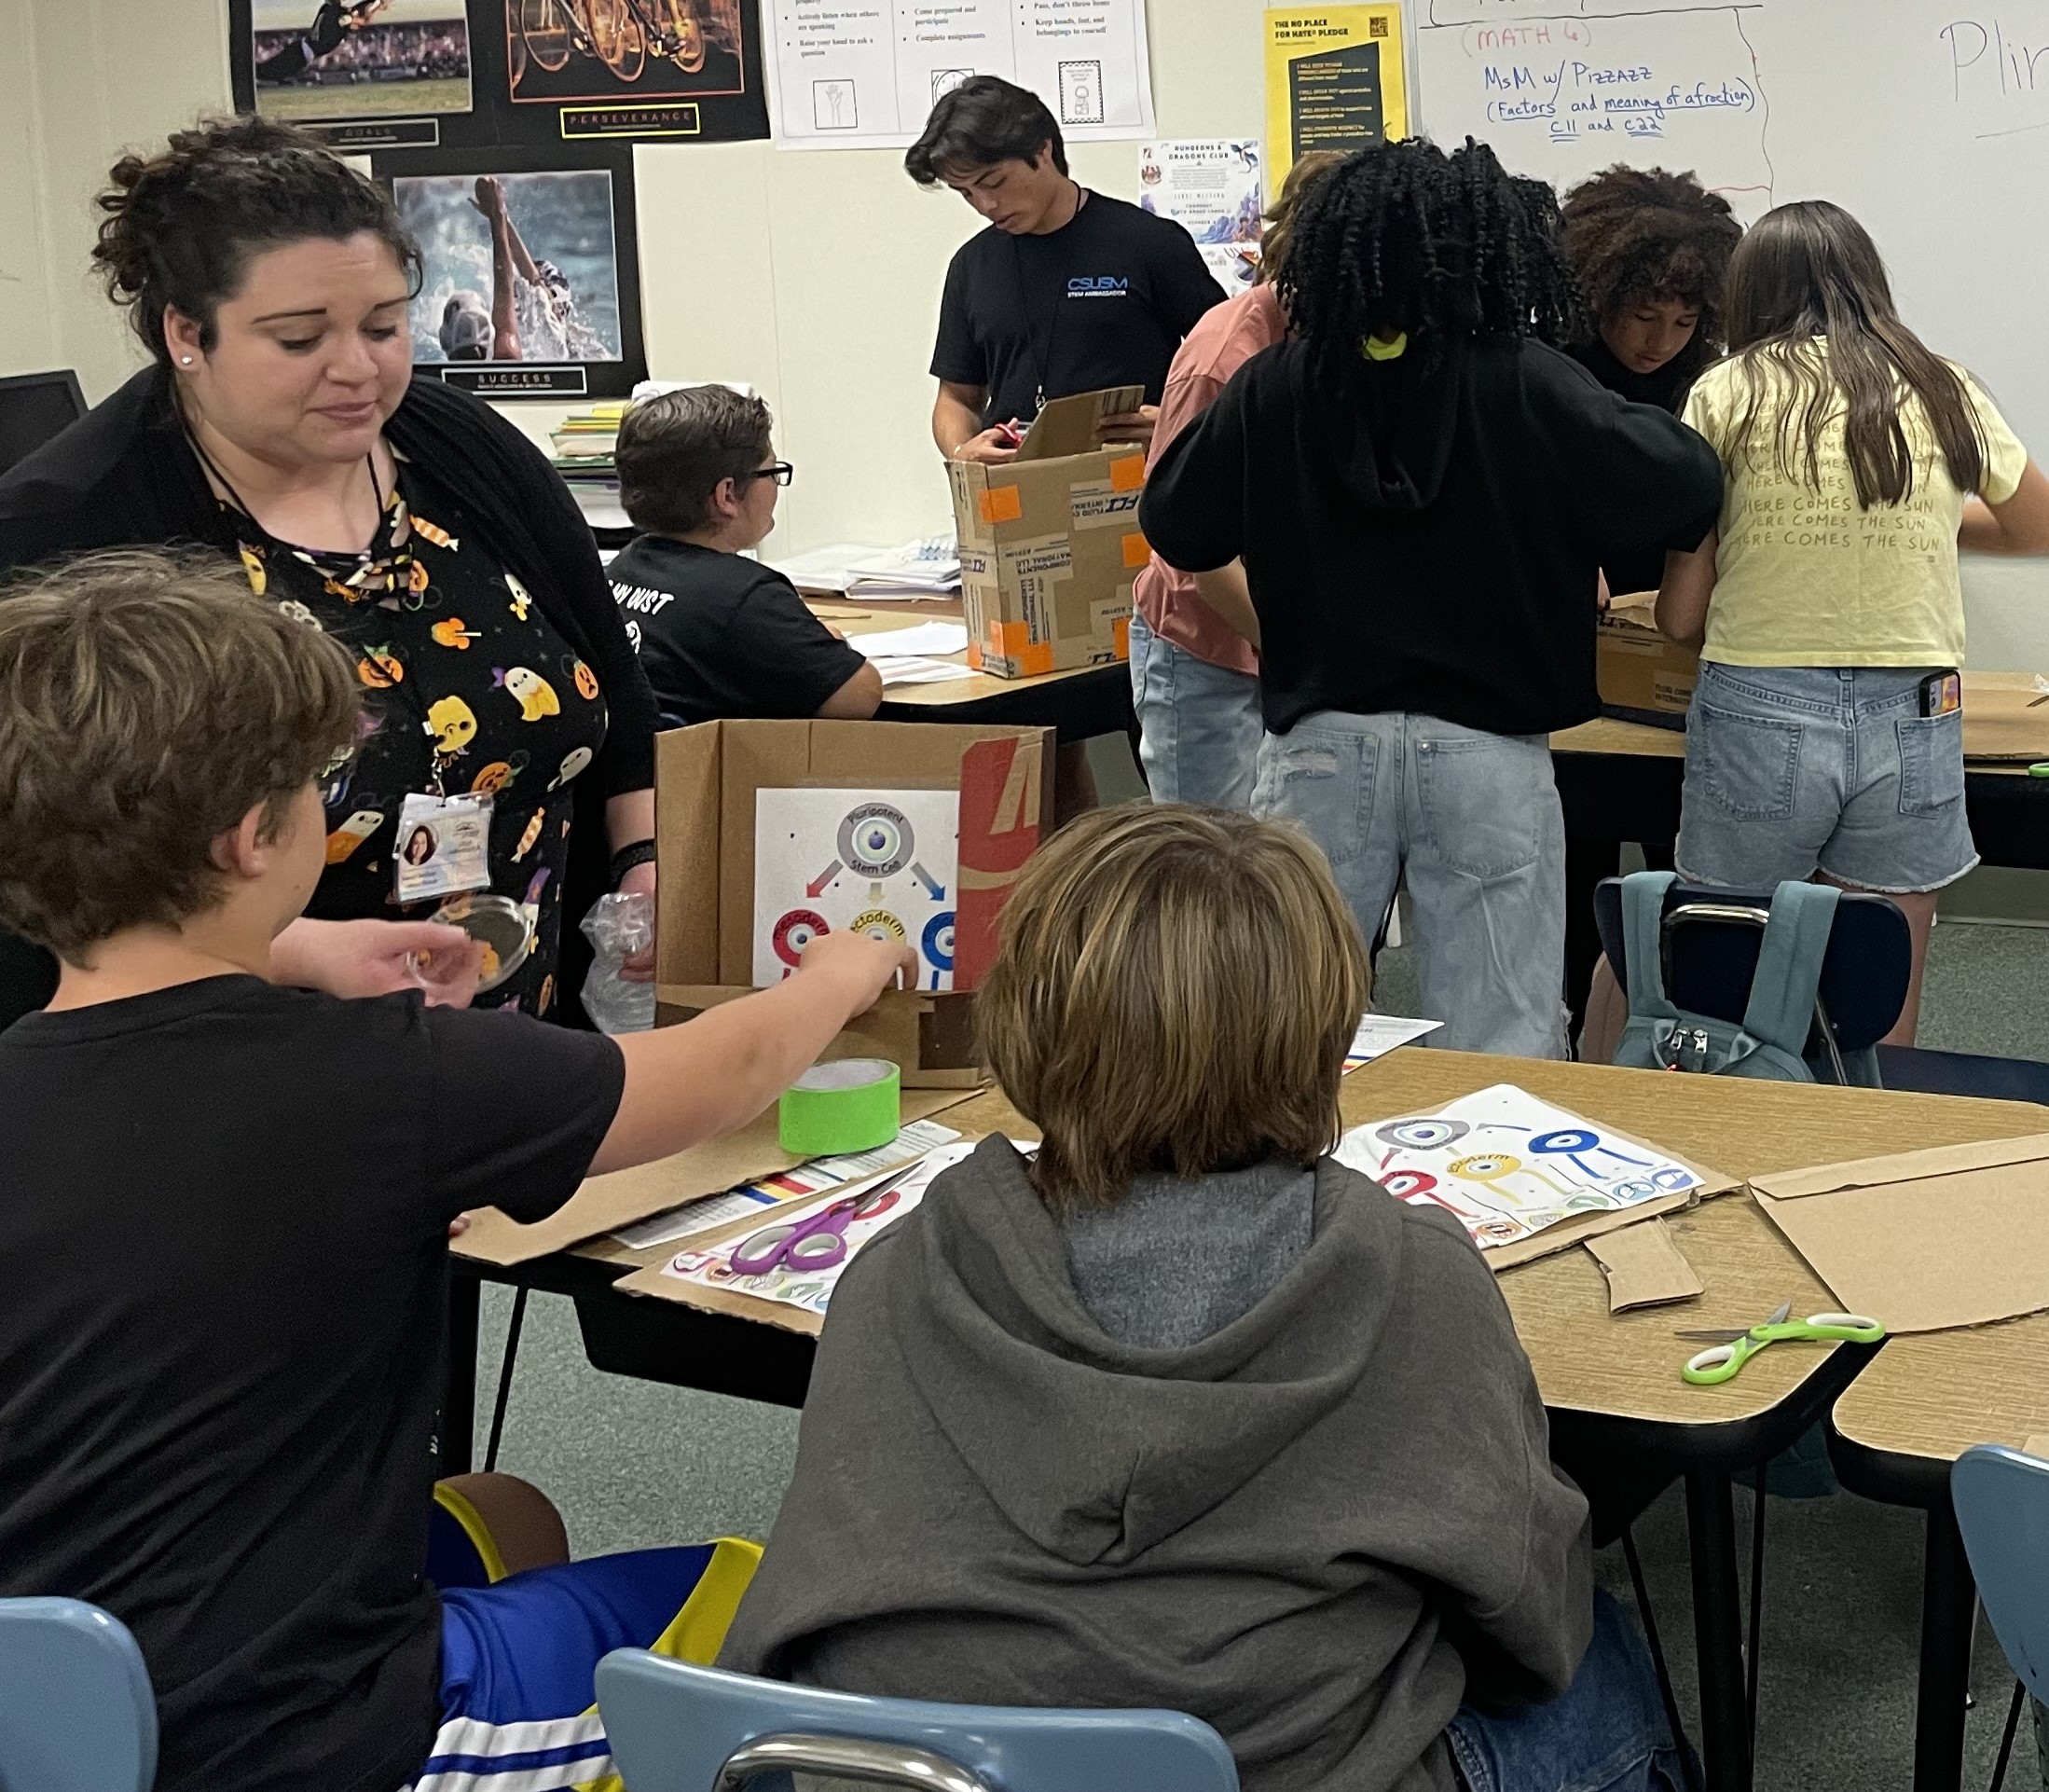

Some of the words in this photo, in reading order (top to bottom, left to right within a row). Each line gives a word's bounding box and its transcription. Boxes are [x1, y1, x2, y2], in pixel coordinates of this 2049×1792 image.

[1318, 28, 1348, 36] PLEDGE
[1571, 94, 1597, 112] and
[1604, 97, 1665, 119] meaning
[1667, 85, 1681, 105] of
[570, 110, 691, 125] PERSEVERANCE
[1588, 117, 1615, 131] and
[1067, 277, 1128, 291] CSUSM
[478, 373, 551, 384] SUCCESS
[1794, 497, 1851, 511] COMES
[1904, 500, 1933, 514] SUN
[1793, 514, 1848, 528] COMES
[1857, 516, 1886, 530] THE
[1895, 516, 1925, 531] SUN
[1784, 531, 1850, 547] COMES
[1863, 534, 1897, 549] THE
[1908, 538, 1940, 552] SUN
[849, 860, 878, 875] Stem
